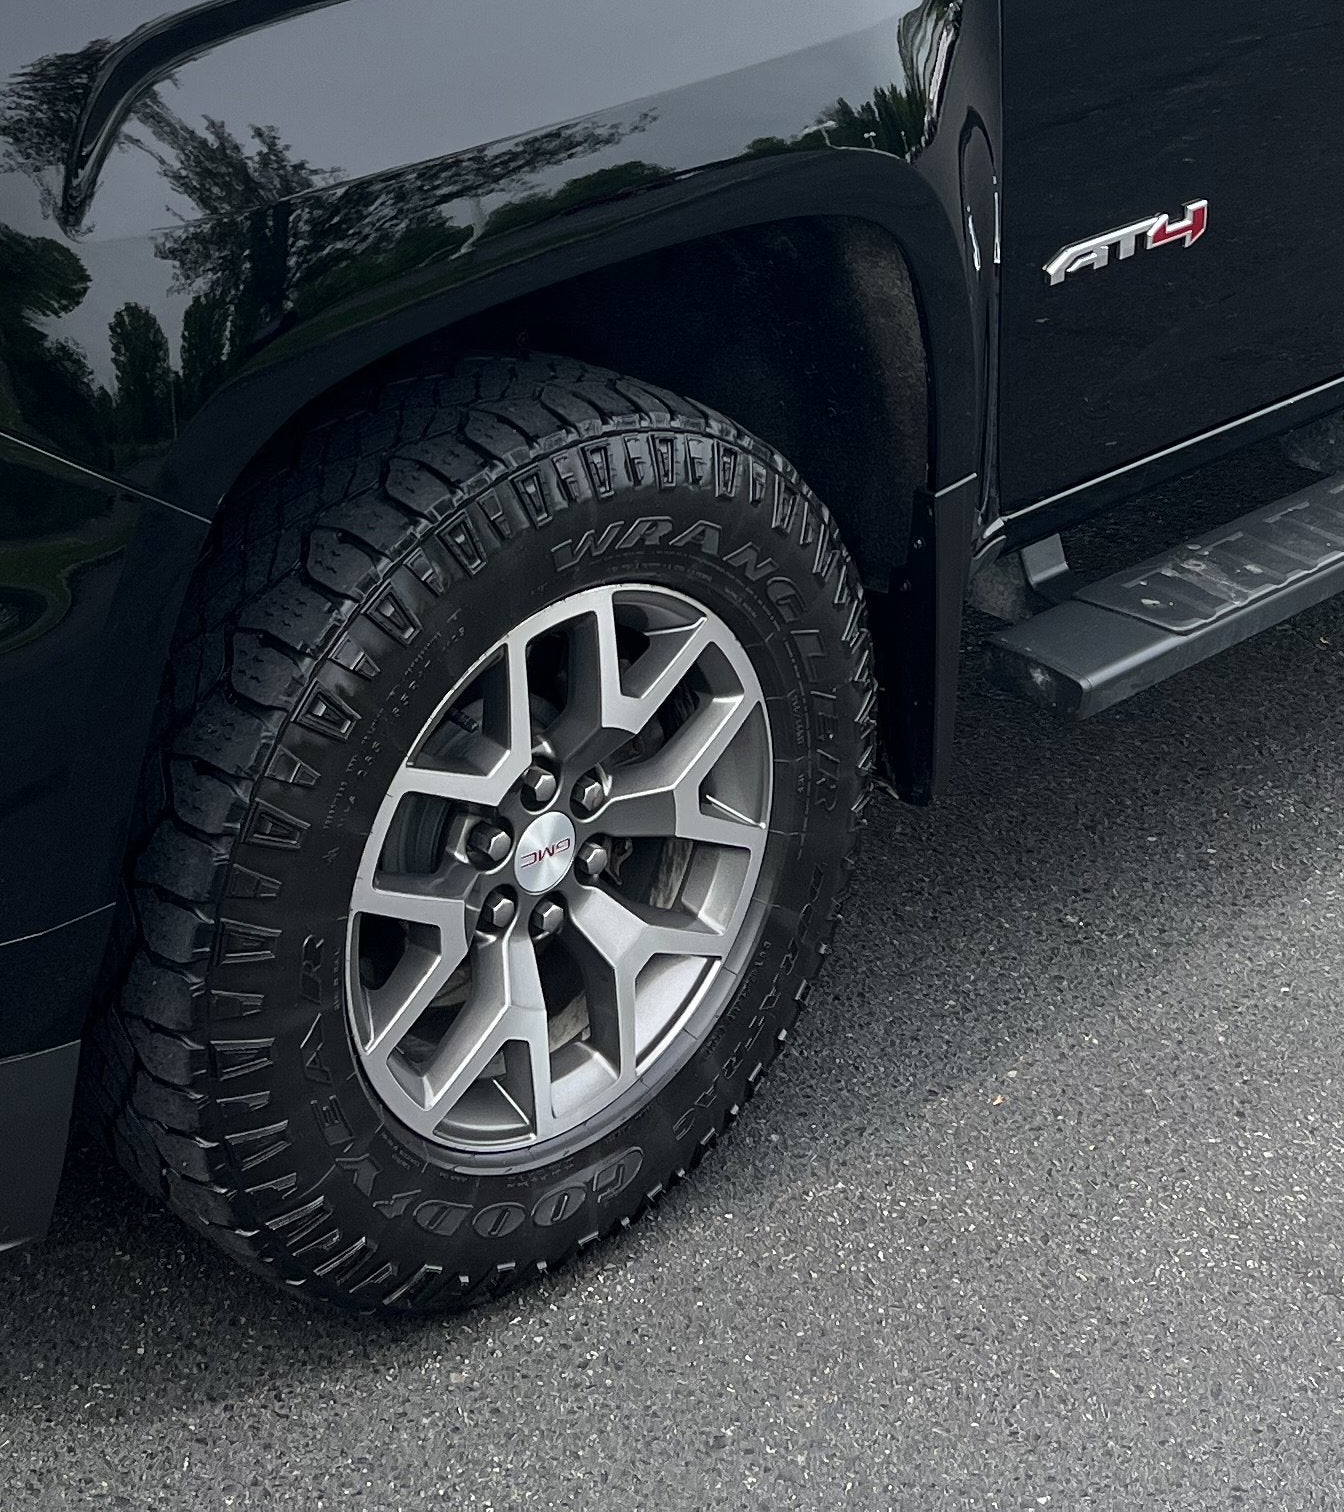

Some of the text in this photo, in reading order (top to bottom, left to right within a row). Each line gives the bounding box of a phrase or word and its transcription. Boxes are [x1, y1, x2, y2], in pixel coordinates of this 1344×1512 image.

[1042, 199, 1208, 286] AT4
[551, 516, 840, 812] WRANGLER
[520, 838, 571, 869] GMC
[299, 934, 644, 1239] GOODYEAR
